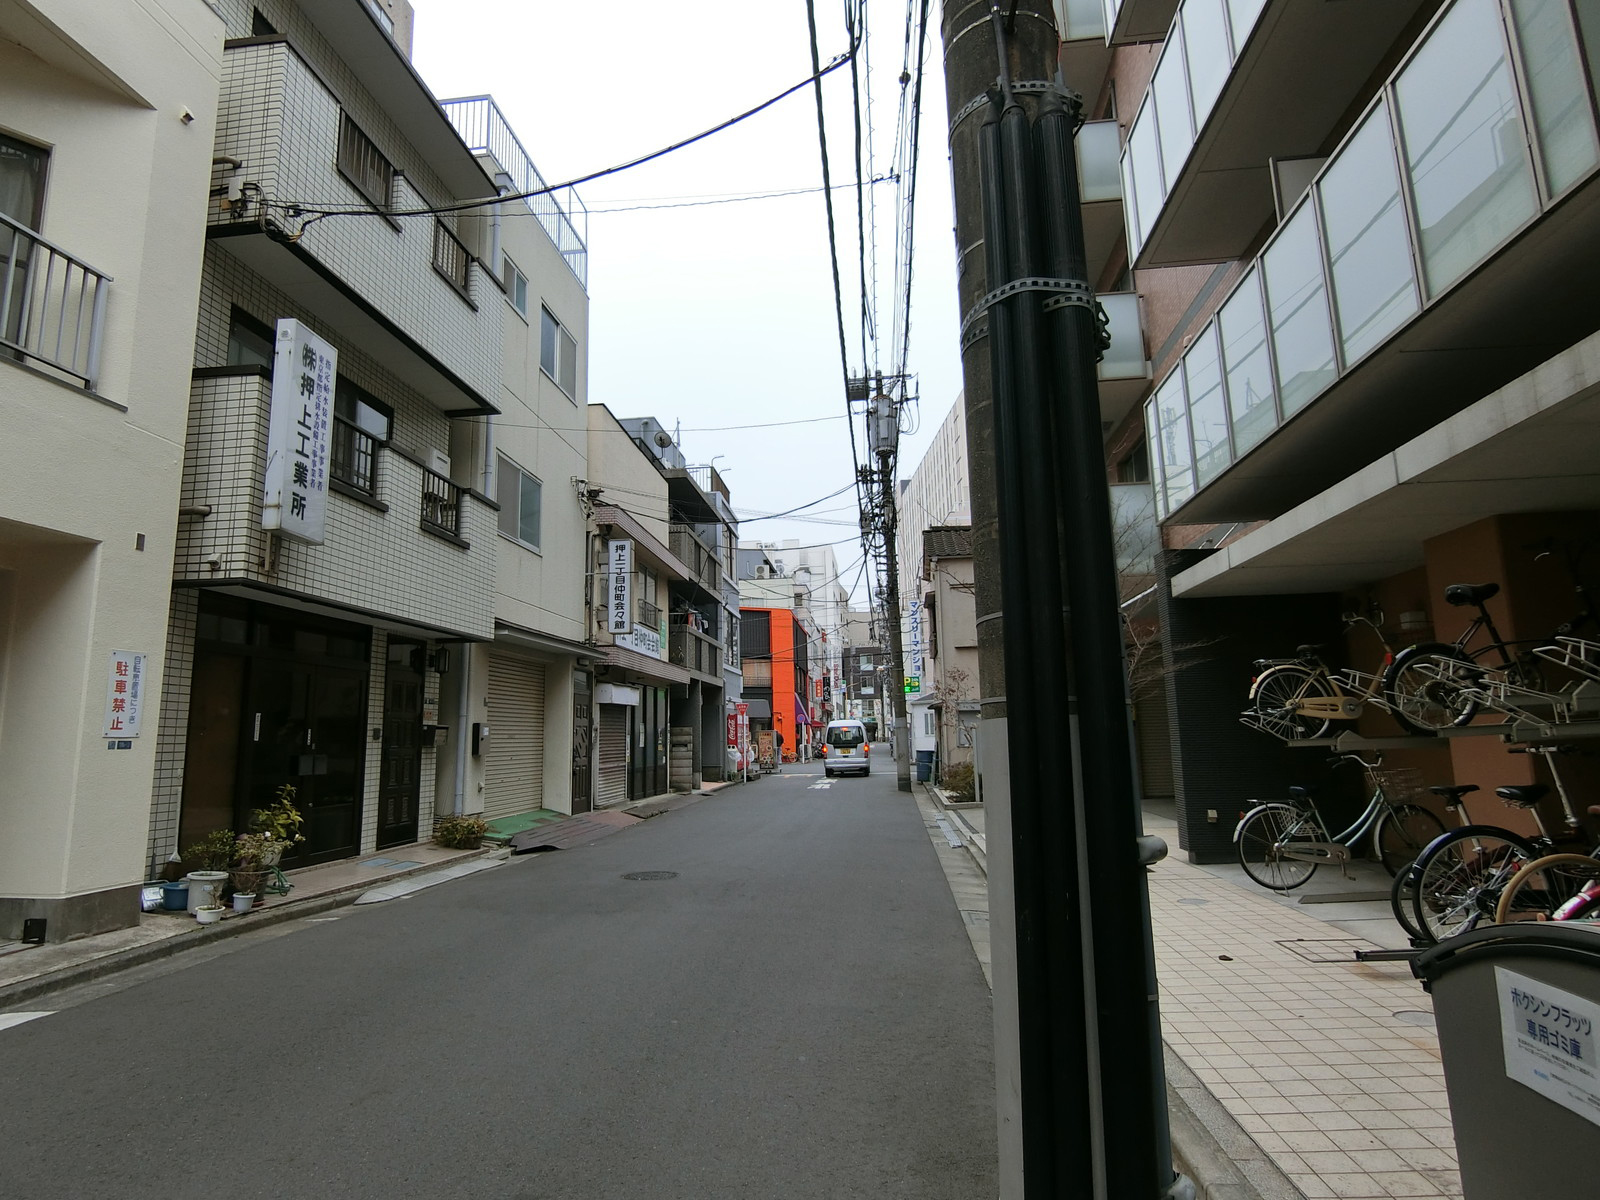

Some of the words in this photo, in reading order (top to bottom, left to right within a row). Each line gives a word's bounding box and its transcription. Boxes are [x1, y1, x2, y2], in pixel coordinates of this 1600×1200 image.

[613, 544, 626, 630] 押上一丁目仲町会々館
[110, 660, 130, 731] 駐車禁止
[904, 677, 911, 687] P
[1510, 986, 1592, 1037] ホクシンフラッツ
[1525, 1018, 1583, 1061] 専用ゴミ庫
